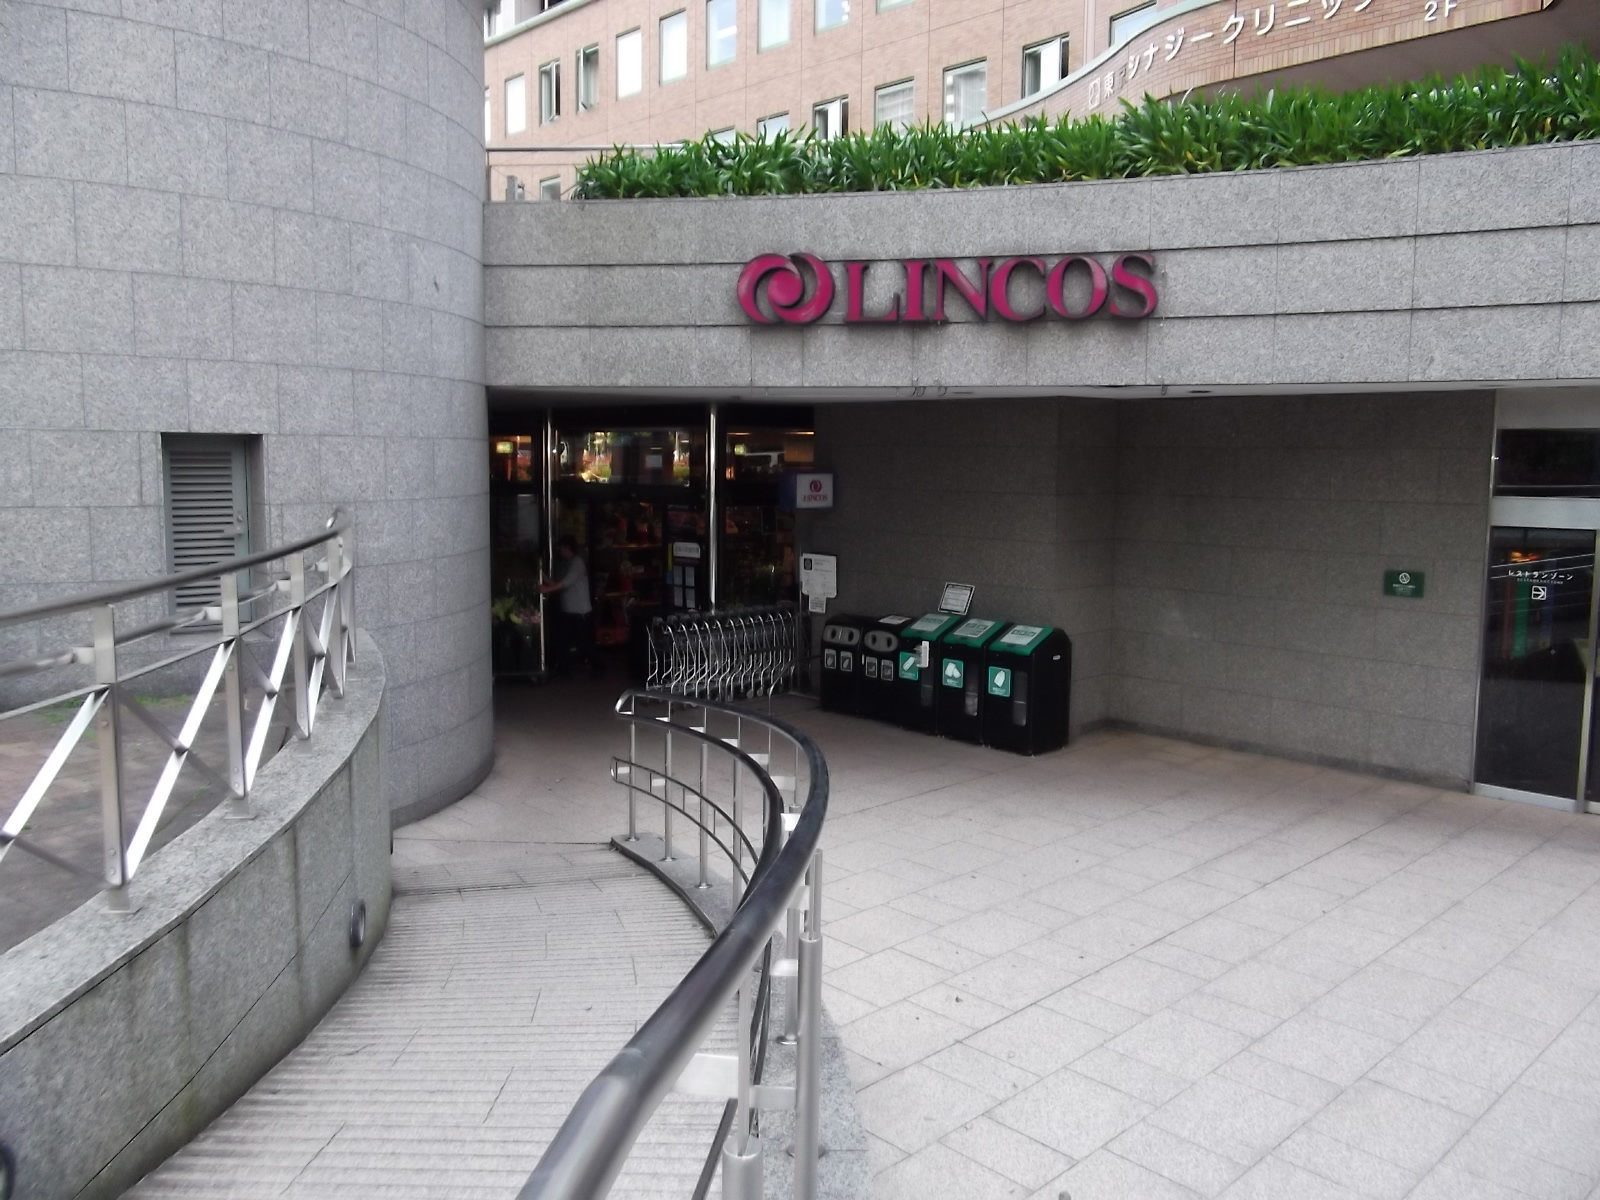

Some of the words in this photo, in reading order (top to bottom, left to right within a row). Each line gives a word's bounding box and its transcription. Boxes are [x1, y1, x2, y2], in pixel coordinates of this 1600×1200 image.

[1424, 0, 1458, 22] 2F
[843, 253, 1159, 324] LINCOS
[1508, 570, 1574, 581] レストランゾーン
